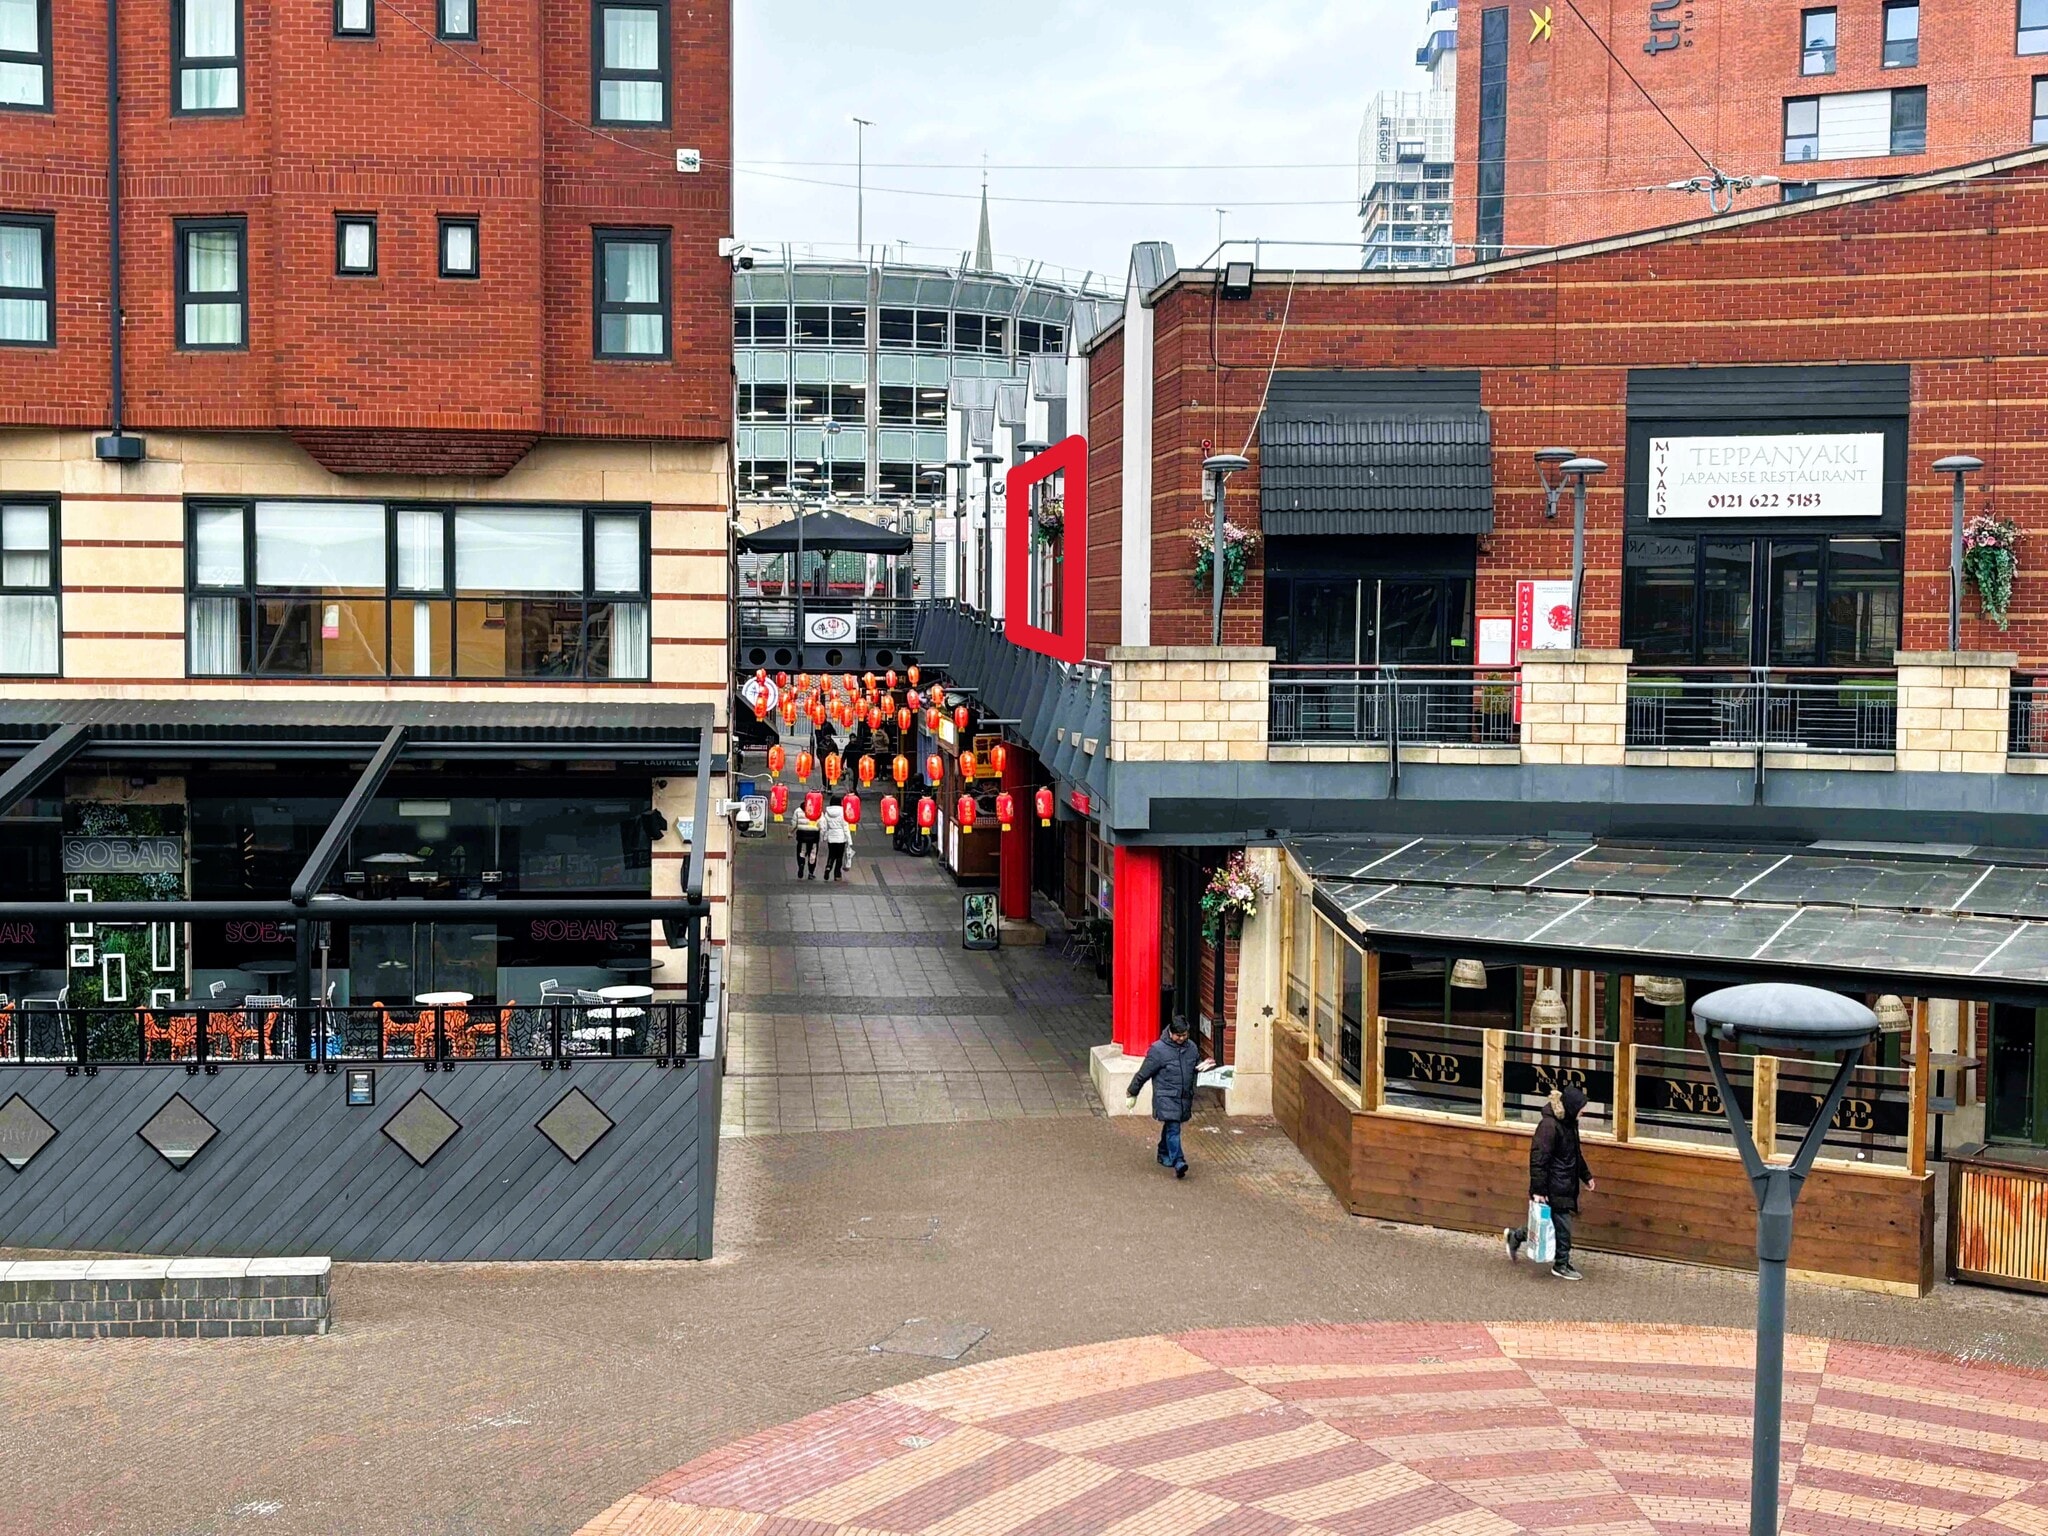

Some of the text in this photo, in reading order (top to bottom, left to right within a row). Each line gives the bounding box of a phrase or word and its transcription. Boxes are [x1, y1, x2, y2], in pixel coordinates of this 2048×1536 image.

[1379, 129, 1388, 163] GROUP
[1690, 444, 1859, 469] TEPPANYAKI
[1655, 441, 1670, 515] MIYAKO
[1680, 469, 1867, 486] JAPANESE RESTAURANT
[1708, 493, 1821, 508] 0121 622 5183
[1521, 586, 1530, 632] MIYAKO
[65, 840, 180, 868] SOBAR
[531, 919, 618, 941] SOBAR
